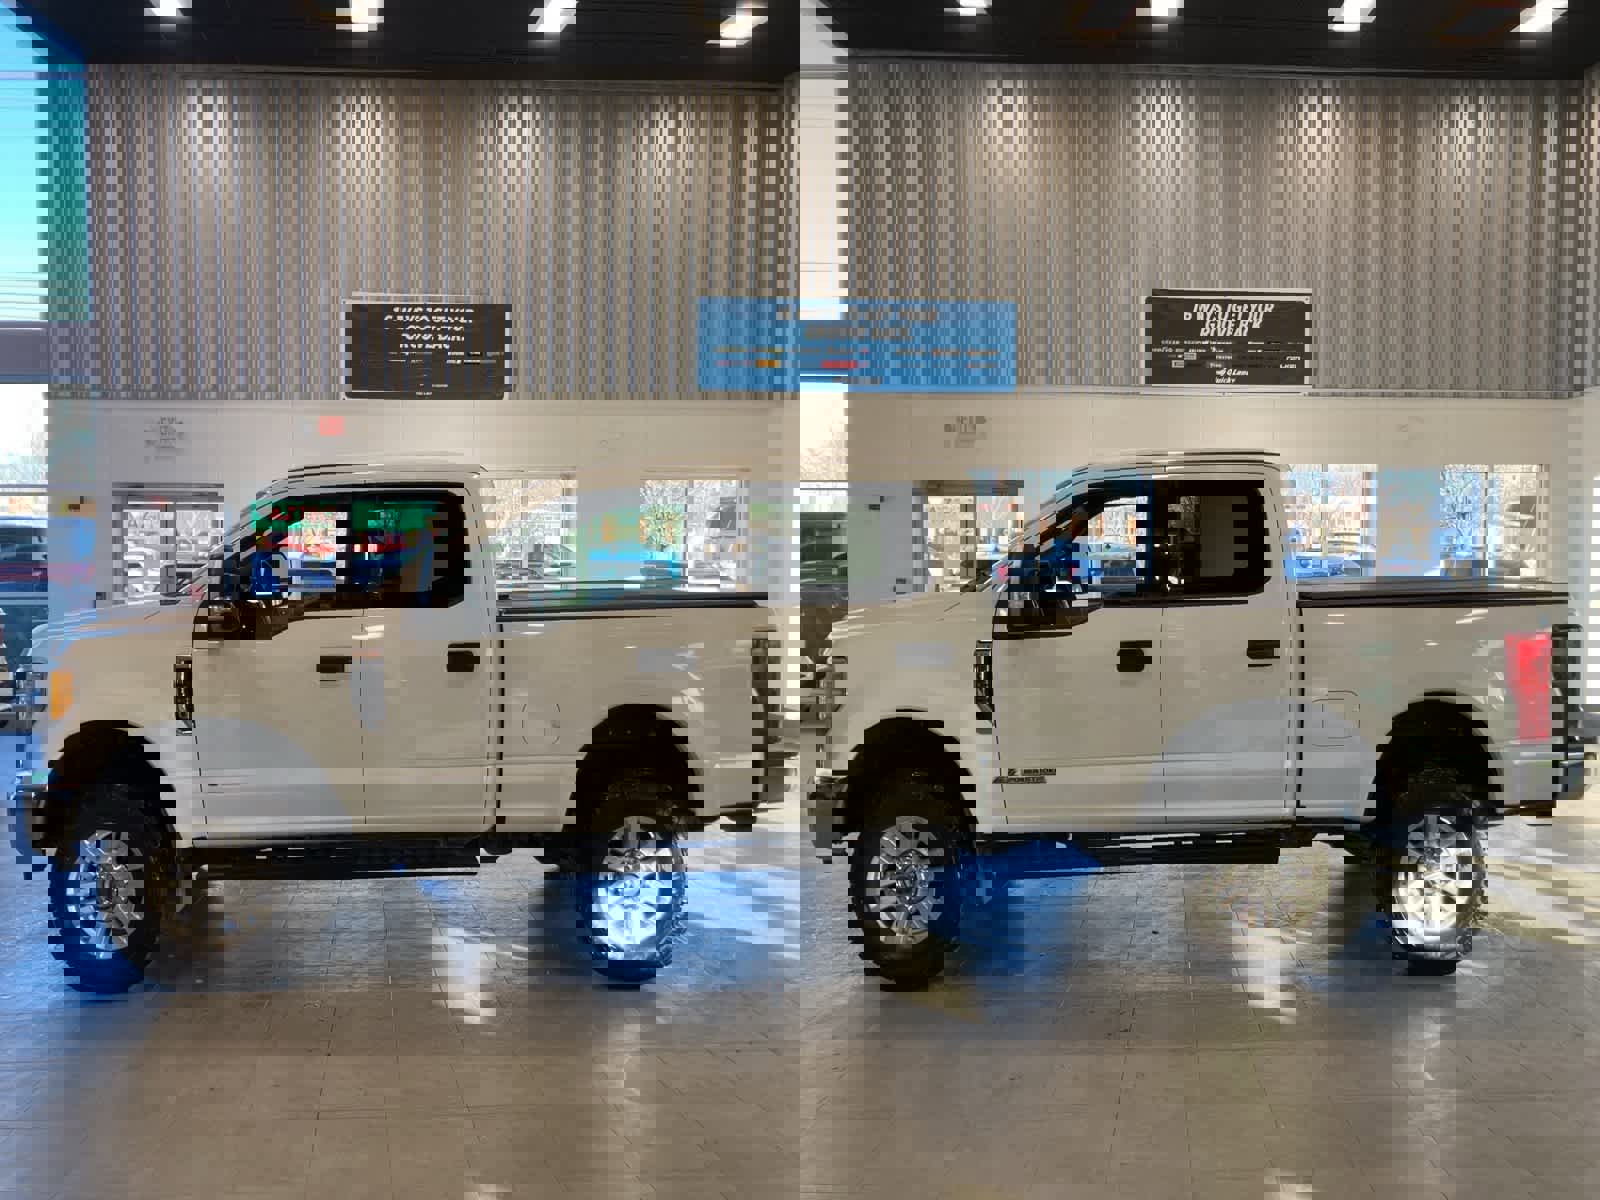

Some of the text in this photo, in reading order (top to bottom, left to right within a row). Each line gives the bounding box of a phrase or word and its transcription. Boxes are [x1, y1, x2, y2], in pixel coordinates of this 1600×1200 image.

[776, 306, 939, 324] 16 WAYS TO GET YOUR
[805, 325, 915, 342] GROOVE BACK.
[320, 416, 345, 436] EXIT
